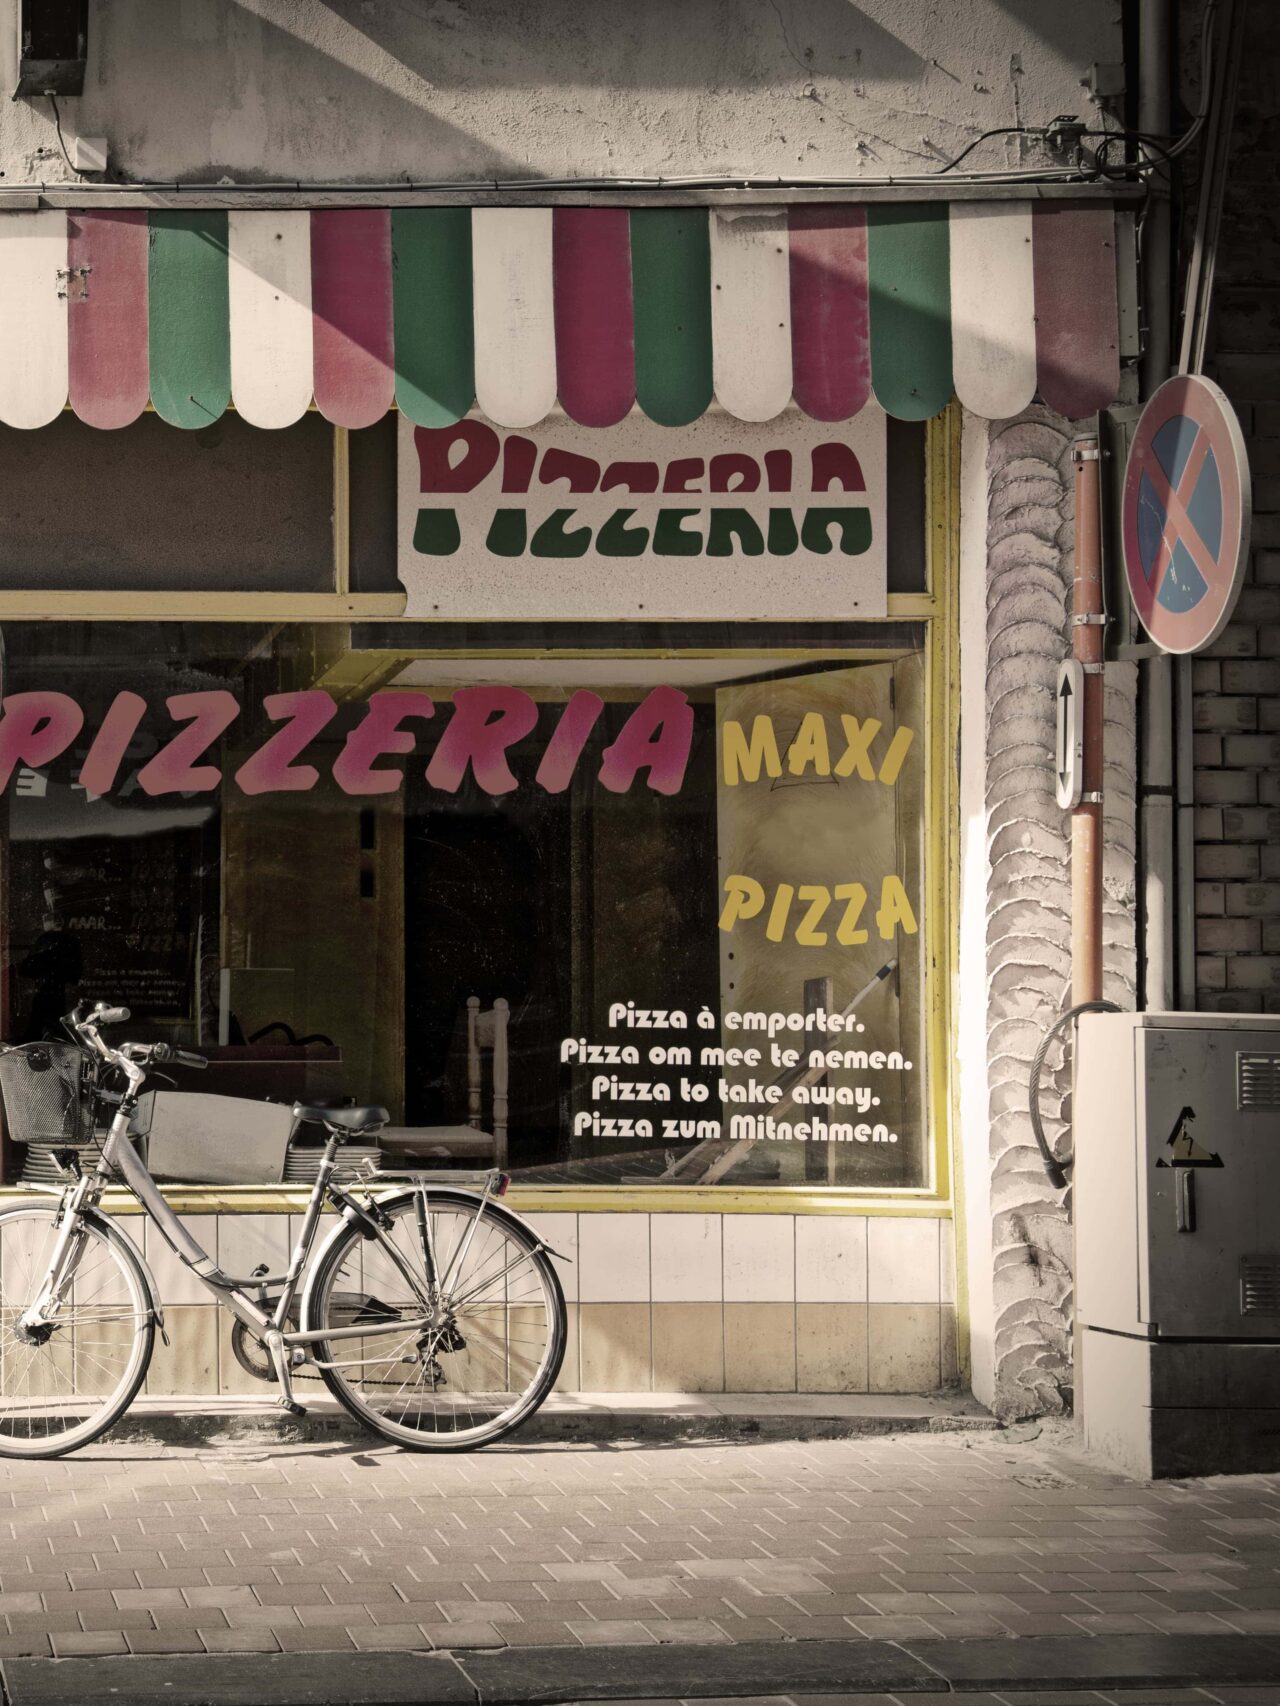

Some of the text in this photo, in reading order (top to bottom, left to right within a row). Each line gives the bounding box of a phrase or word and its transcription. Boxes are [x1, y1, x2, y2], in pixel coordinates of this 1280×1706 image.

[413, 418, 873, 558] PIZZERIA
[722, 711, 915, 787] MAXI
[717, 873, 919, 946] PIZZA
[608, 1000, 866, 1038] Pizza à emporter.
[560, 1037, 913, 1071] Pizza om mee te nemen.
[592, 1074, 881, 1113] Pizza to take away.
[574, 1111, 898, 1143] Pizza zum Mitnehmen.
